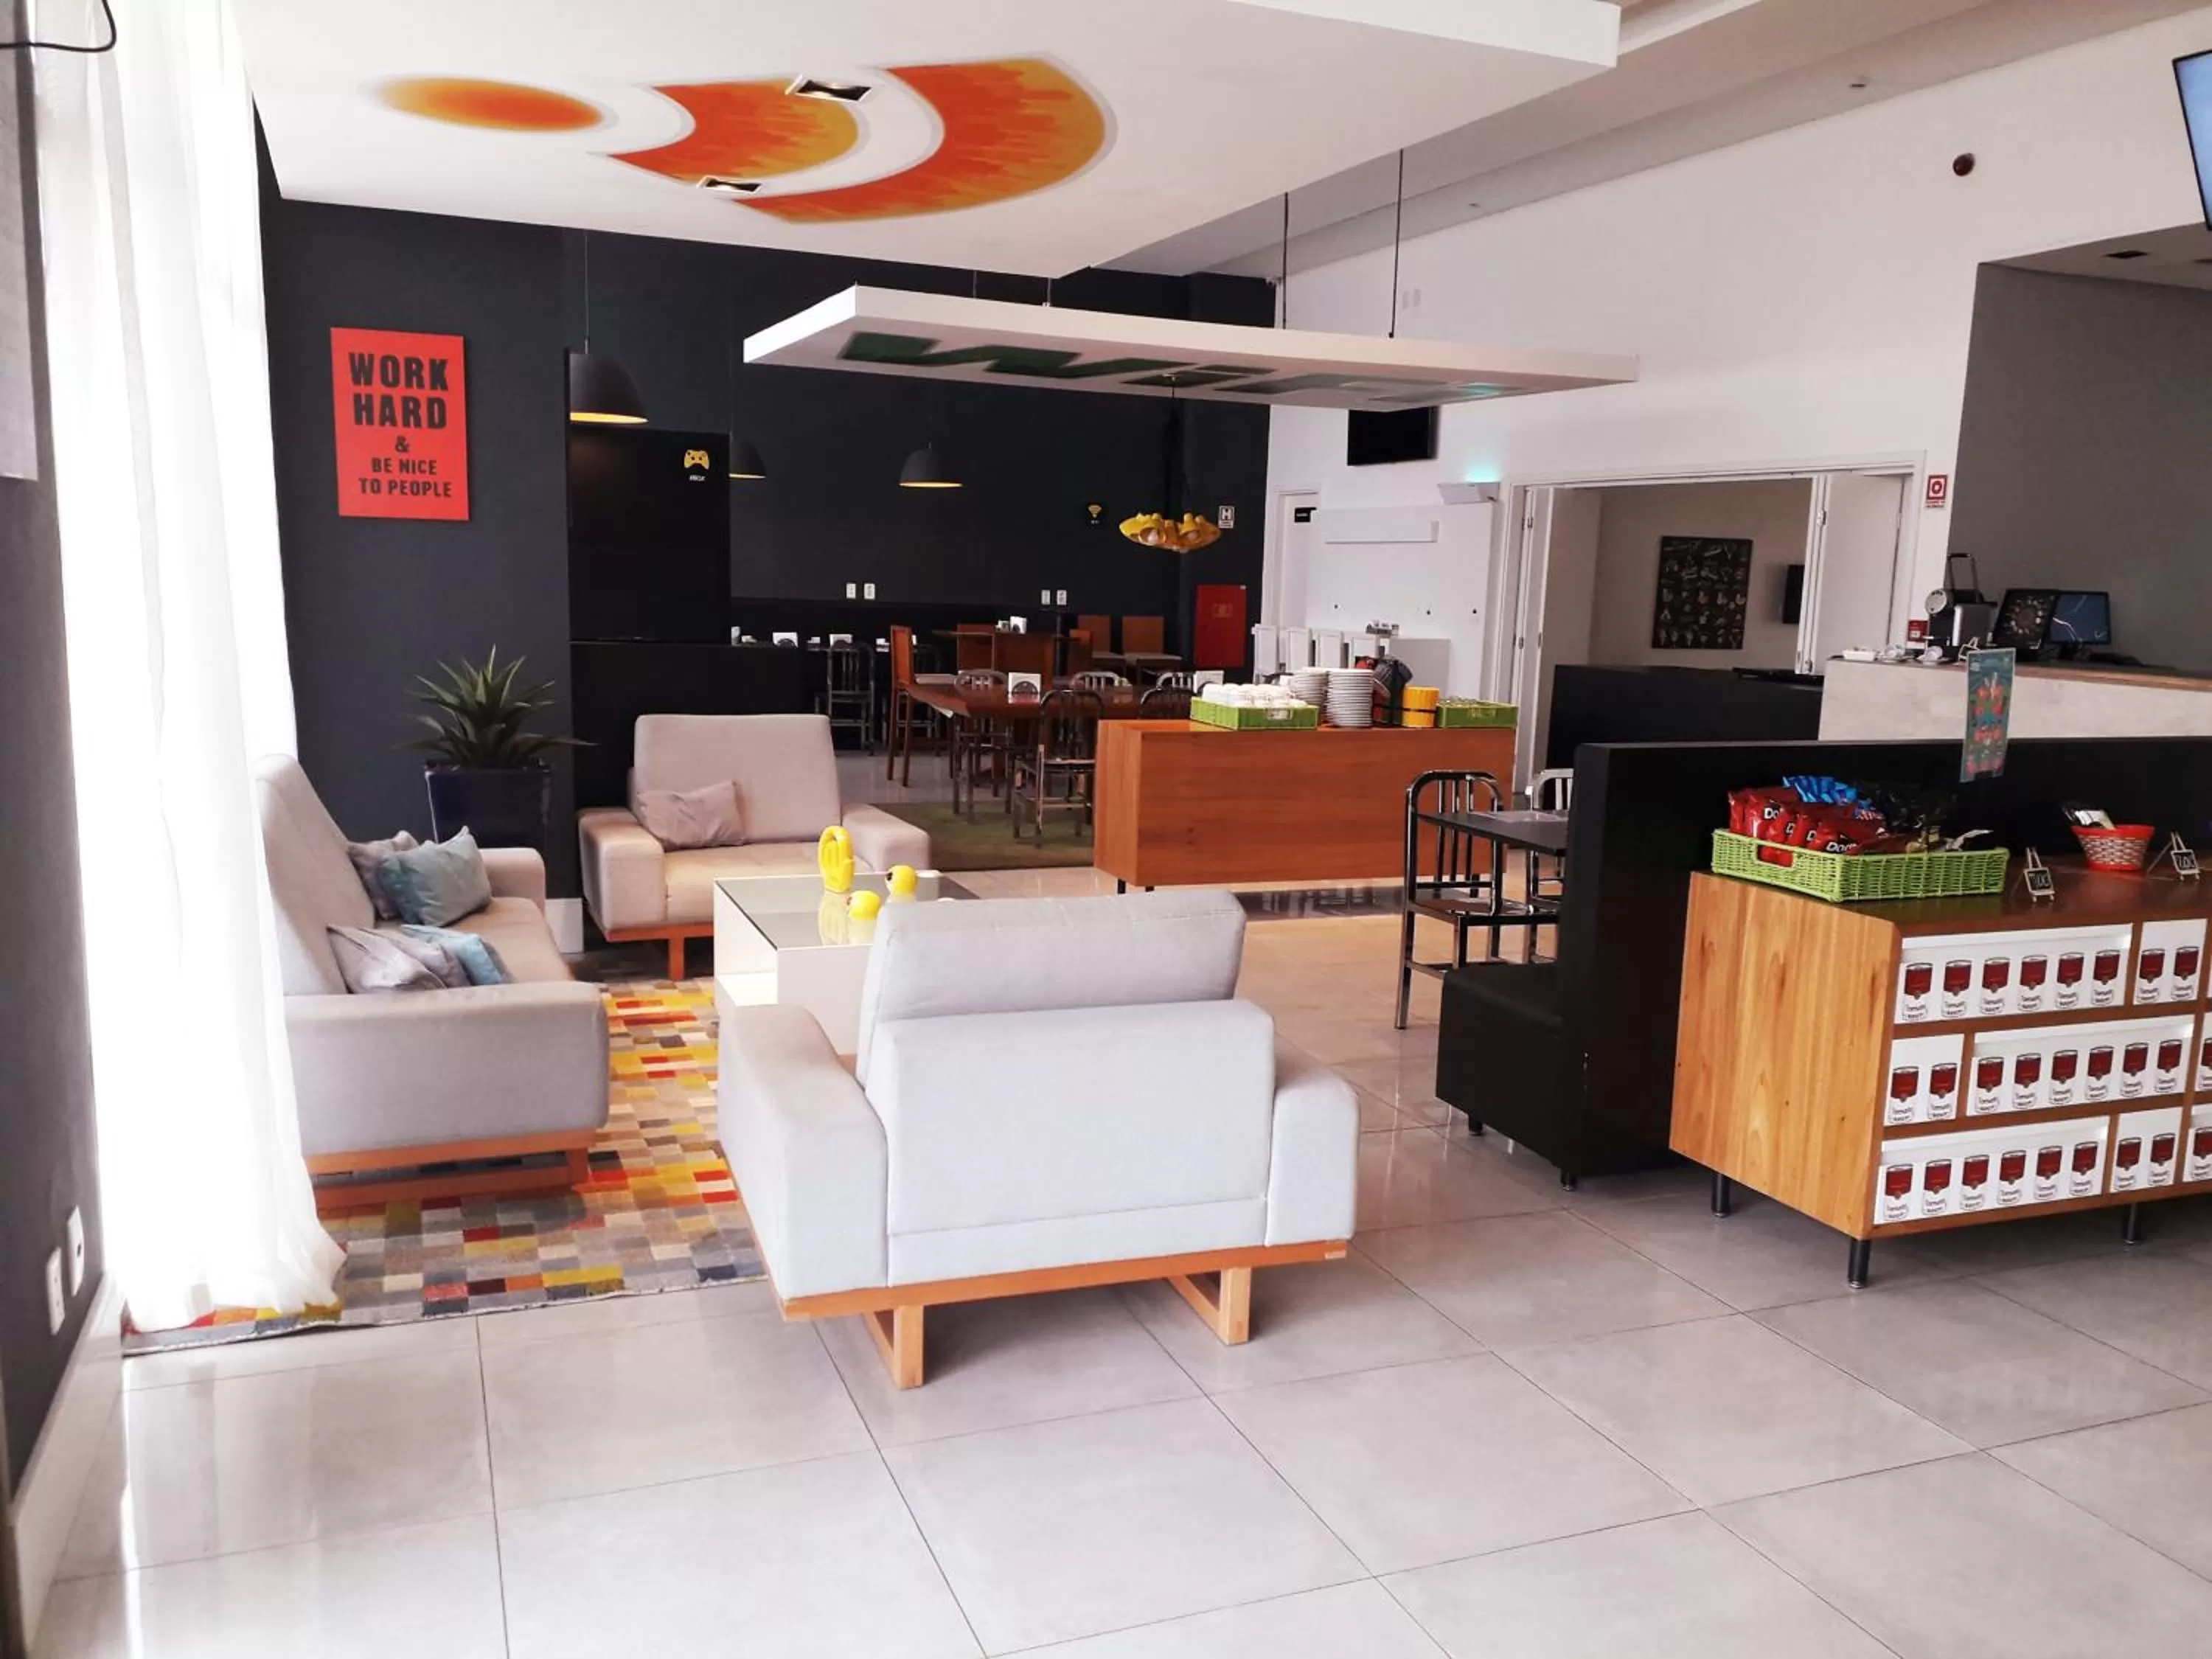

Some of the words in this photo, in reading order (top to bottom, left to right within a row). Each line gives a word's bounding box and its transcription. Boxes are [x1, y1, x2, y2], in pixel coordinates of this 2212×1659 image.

[348, 352, 449, 391] WORK
[352, 393, 448, 429] HARD
[394, 435, 410, 453] &
[371, 457, 393, 473] BE
[399, 459, 437, 475] NICE
[358, 478, 381, 495] TO
[388, 480, 452, 498] PEOPLE
